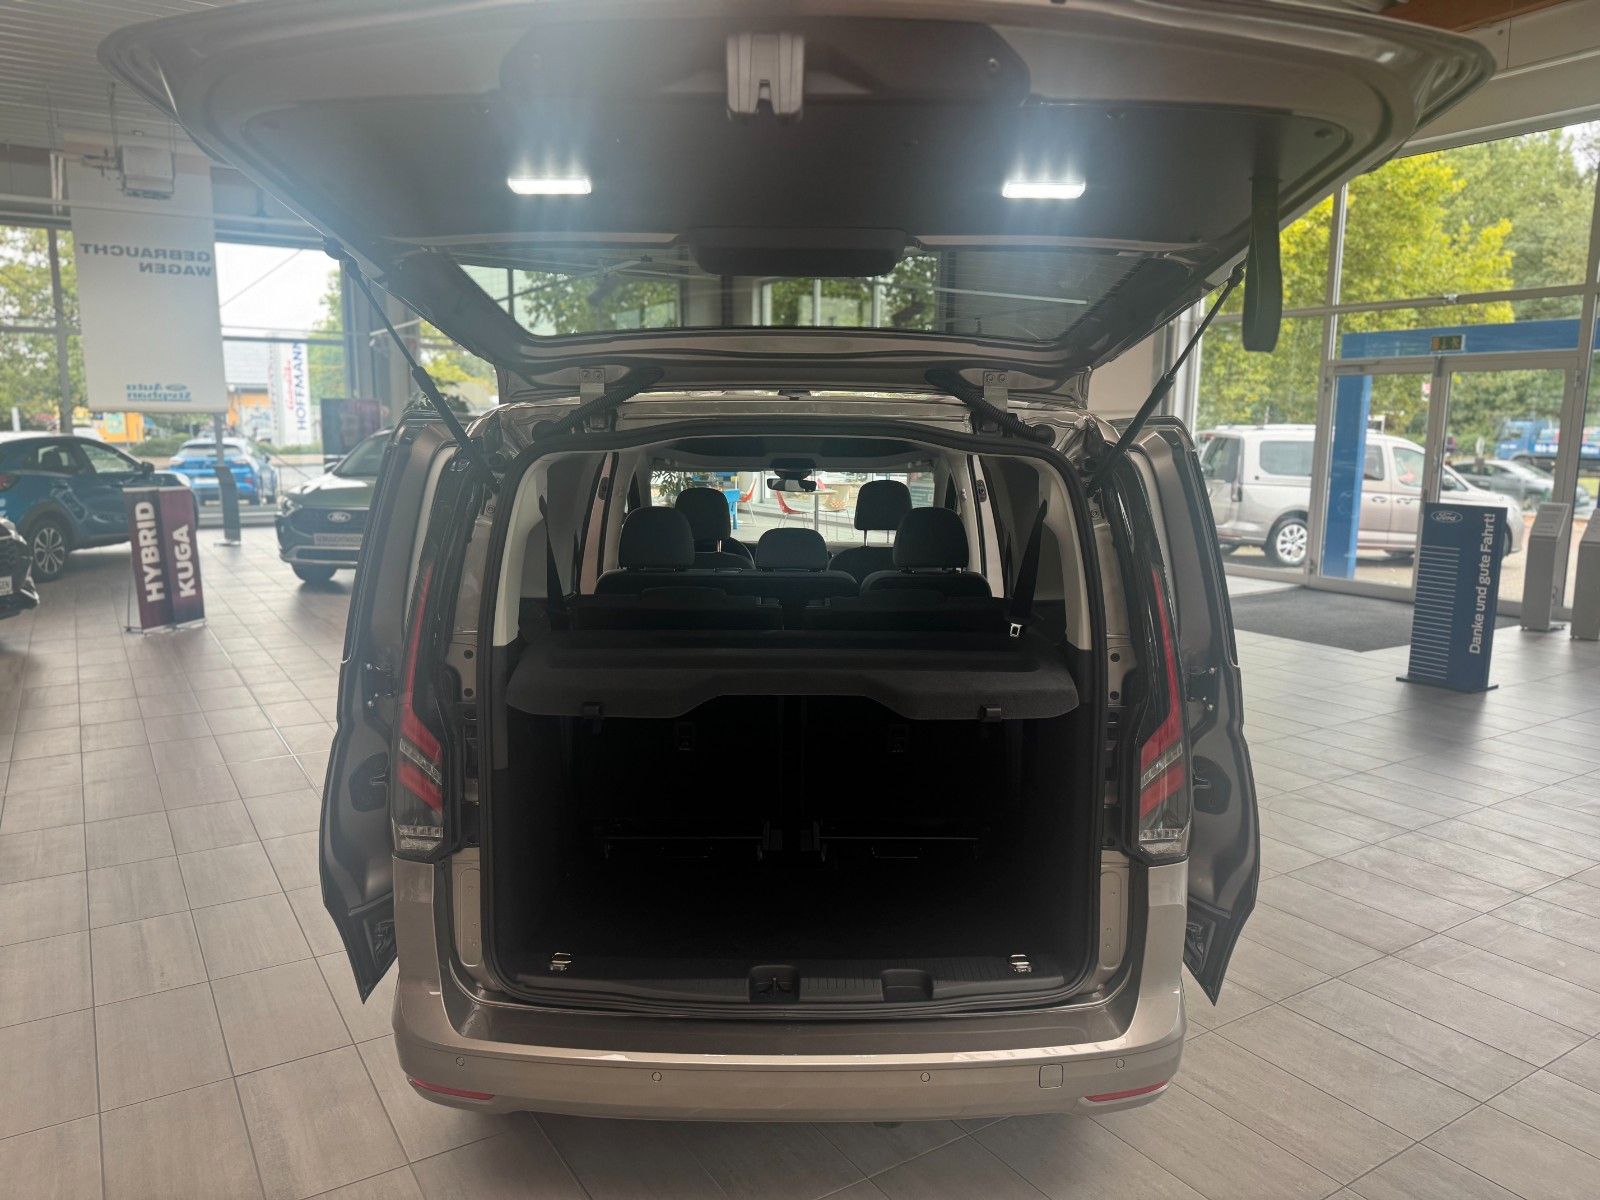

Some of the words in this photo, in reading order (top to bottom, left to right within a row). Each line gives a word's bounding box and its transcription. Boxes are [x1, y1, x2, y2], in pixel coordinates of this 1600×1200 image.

[1434, 511, 1459, 522] Ford
[1480, 513, 1495, 554] Fahrt!
[135, 502, 165, 602] HYBRID
[173, 525, 196, 598] KUGA
[1479, 555, 1491, 585] gute
[1476, 586, 1487, 612] und
[1470, 613, 1485, 653] Danke
